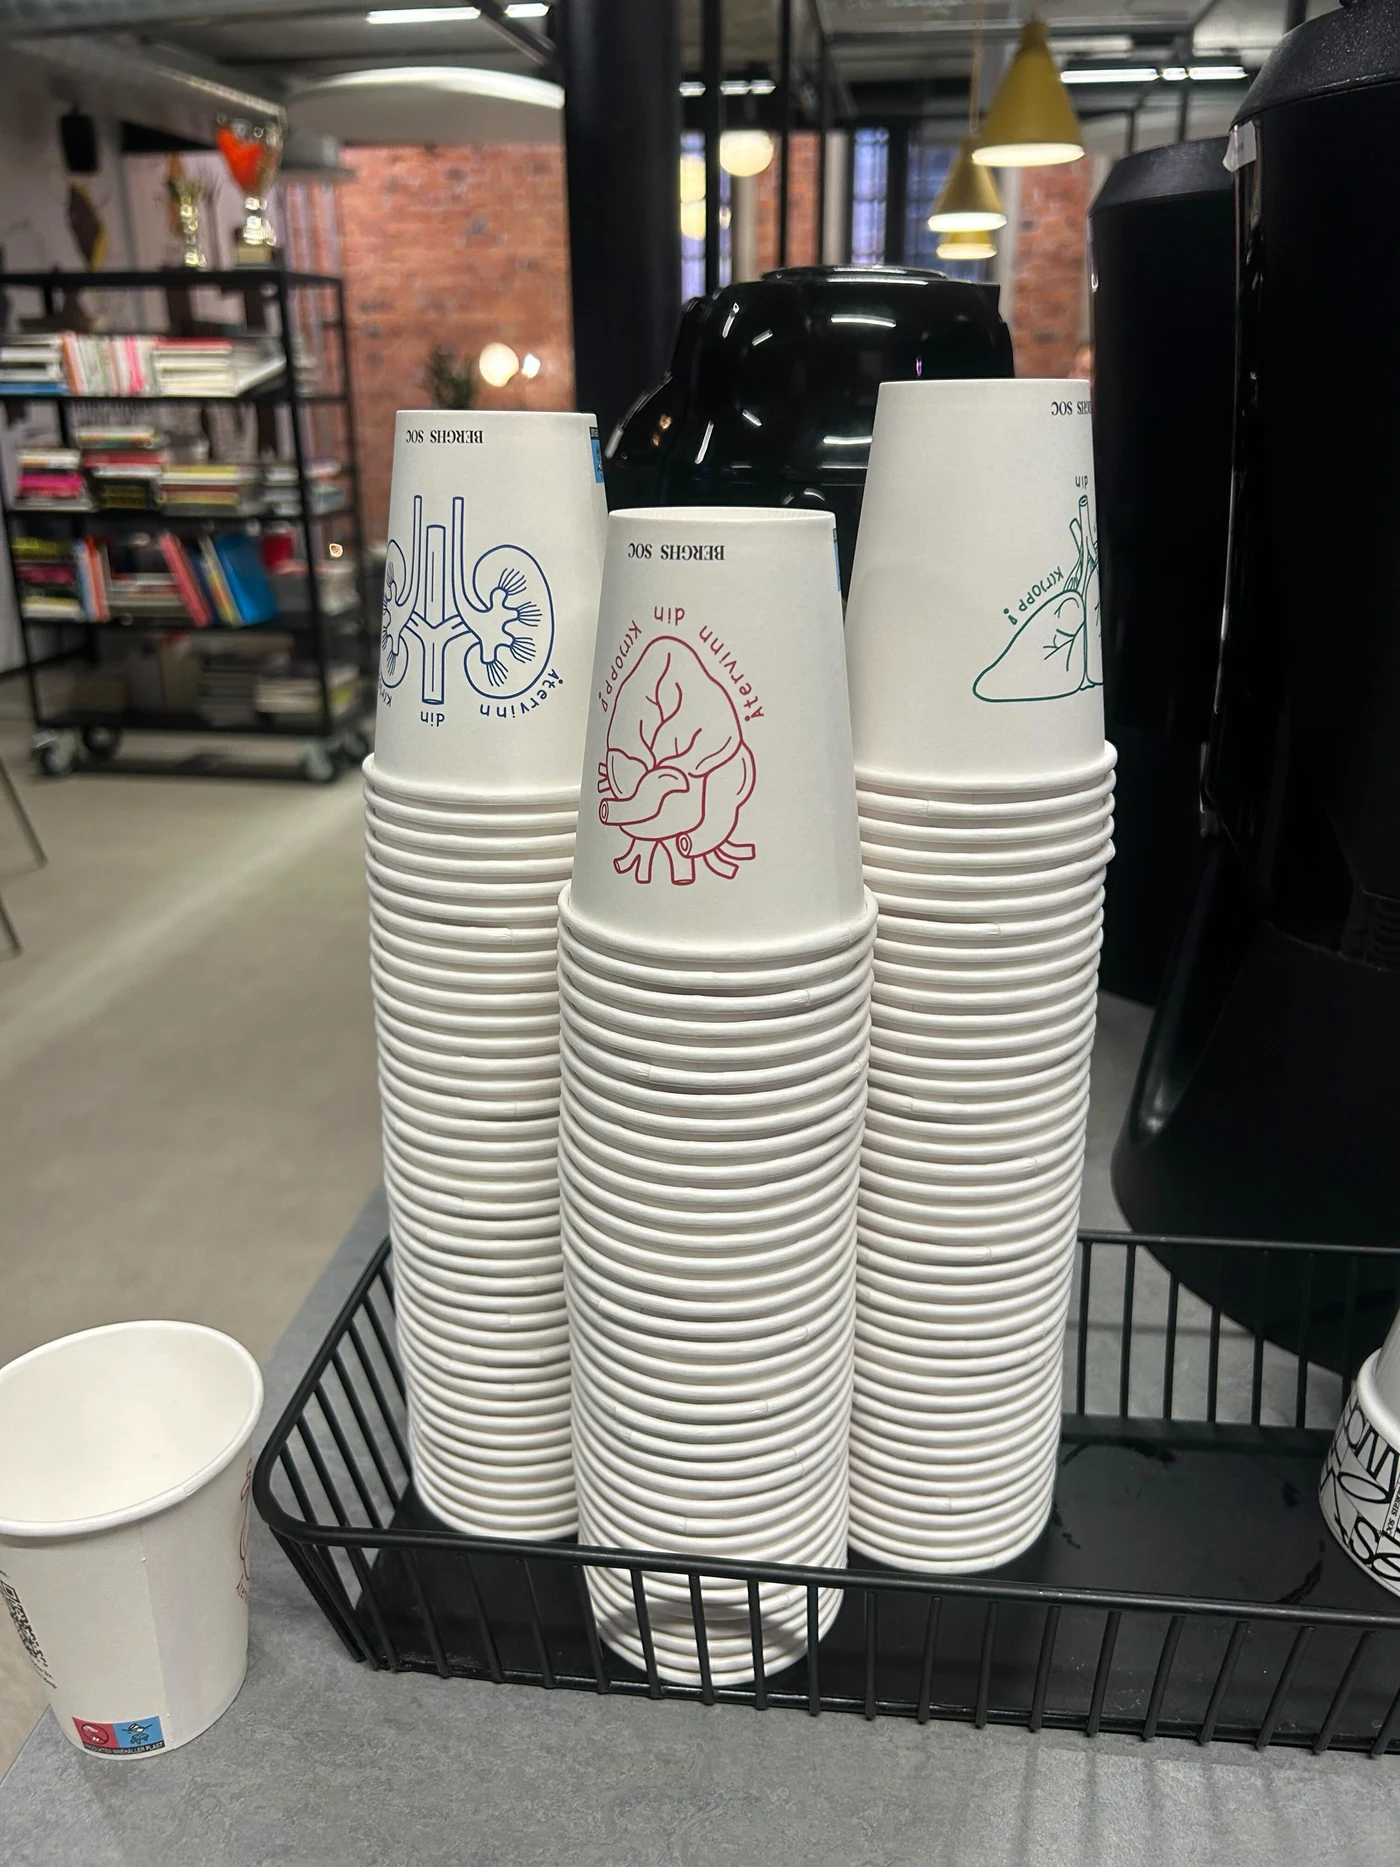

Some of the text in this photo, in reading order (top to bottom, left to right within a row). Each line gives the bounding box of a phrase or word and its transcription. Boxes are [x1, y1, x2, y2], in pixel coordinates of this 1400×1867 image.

[1051, 401, 1073, 416] SOC
[405, 429, 484, 444] BERGHS SOC
[1075, 475, 1089, 488] din
[627, 542, 725, 561] BERGHS SOC
[653, 606, 685, 625] din
[698, 625, 764, 722] Återvinn
[480, 668, 564, 719] Återvinn
[420, 711, 445, 727] din
[145, 1741, 163, 1752] PLAST
